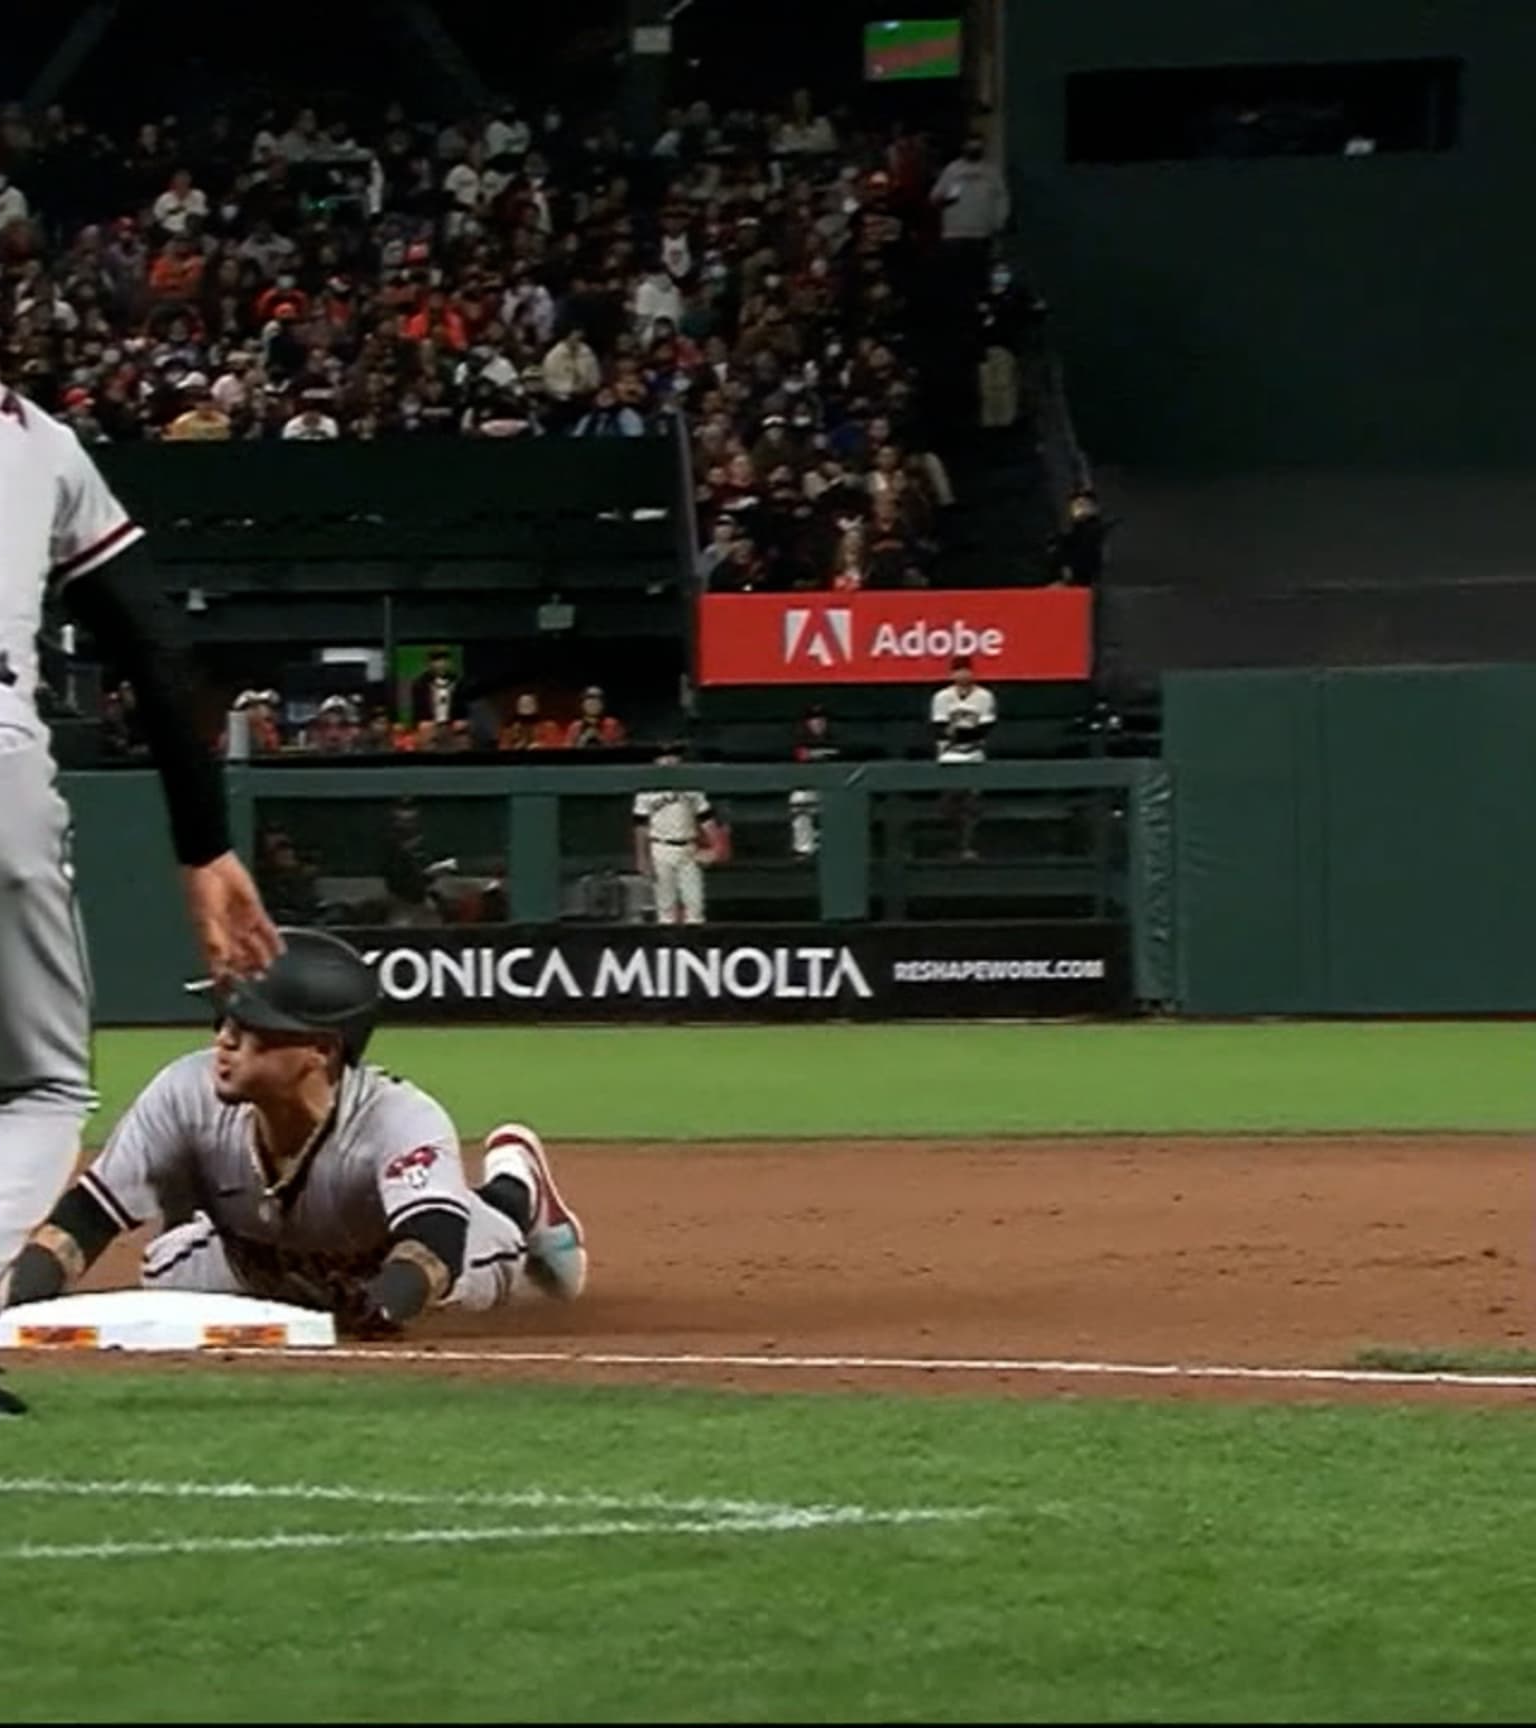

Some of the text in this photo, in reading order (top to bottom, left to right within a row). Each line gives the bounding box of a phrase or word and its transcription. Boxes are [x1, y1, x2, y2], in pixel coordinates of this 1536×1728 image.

[870, 619, 1004, 657] Adobe
[361, 947, 874, 1000] ONICA MINOLTA
[893, 959, 1104, 982] RESHAPEWORK.COM
